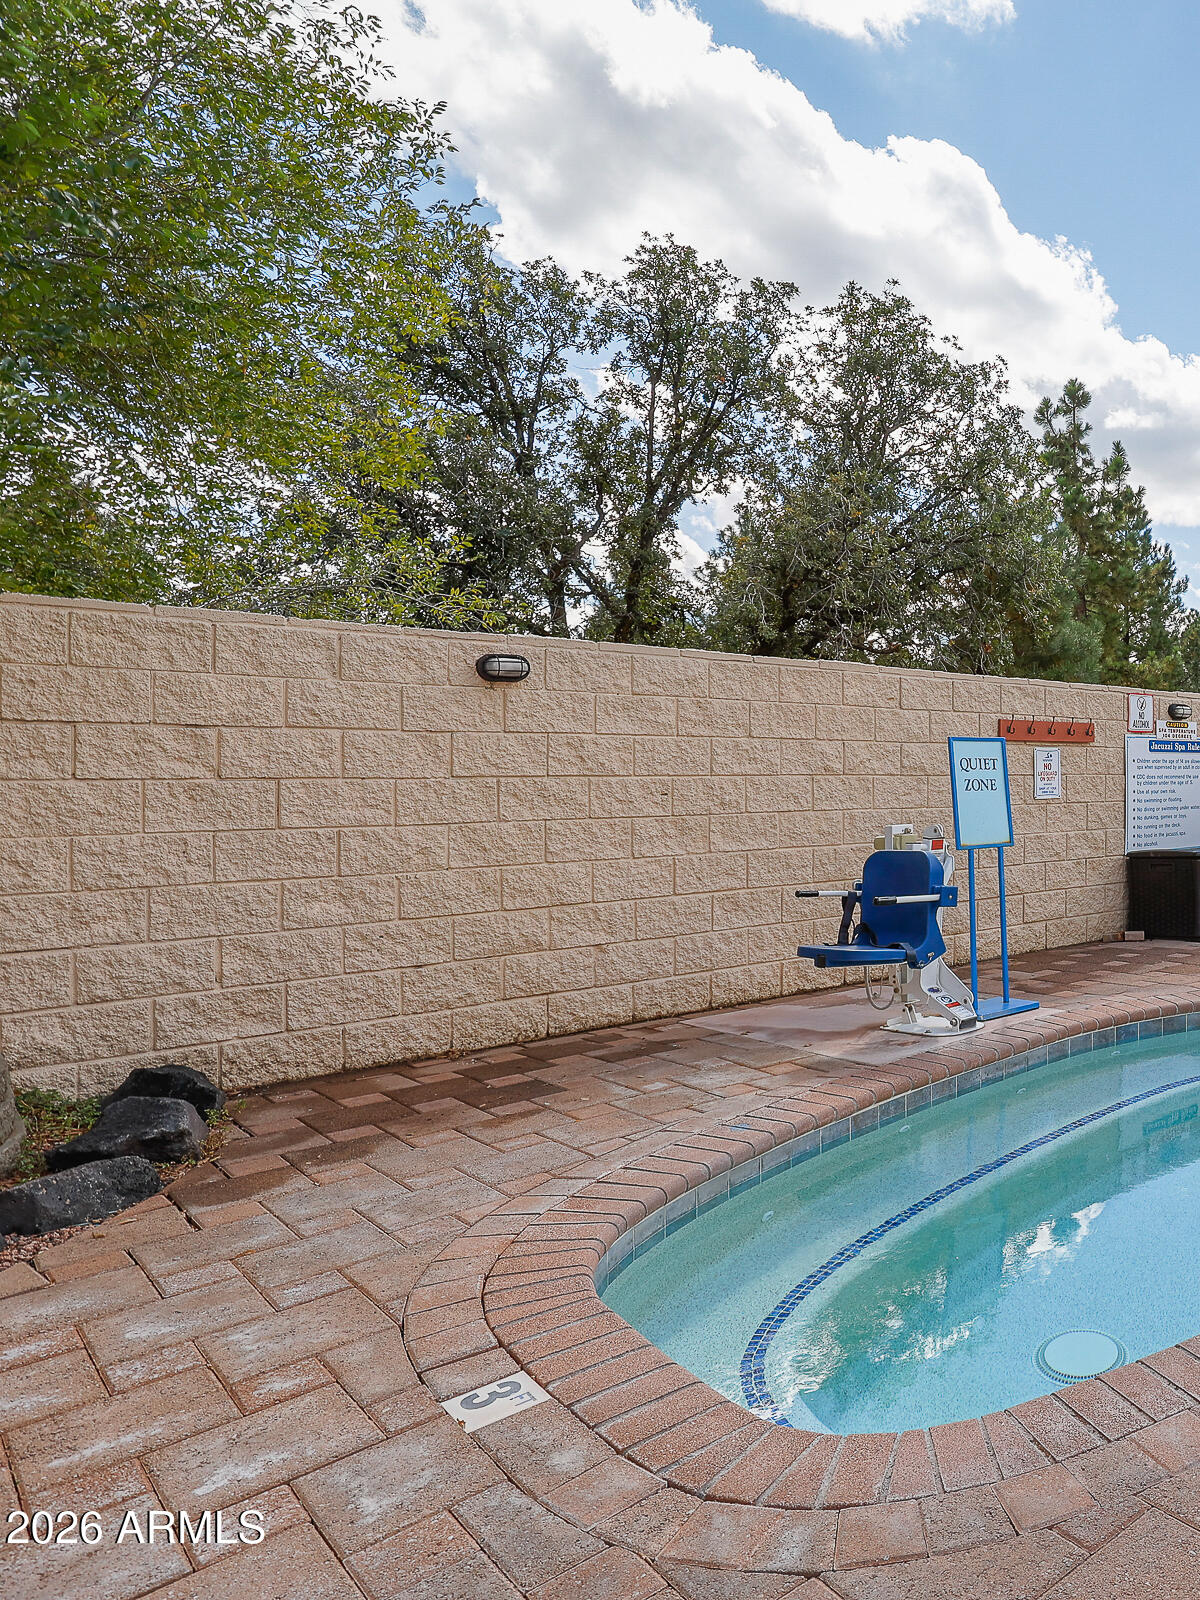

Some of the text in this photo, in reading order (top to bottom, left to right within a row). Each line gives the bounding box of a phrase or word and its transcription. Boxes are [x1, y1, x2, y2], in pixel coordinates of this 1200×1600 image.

[1133, 720, 1150, 728] ALCOHOL
[1175, 743, 1185, 751] Spa
[960, 758, 998, 772] QUIET
[964, 779, 998, 791] ZONE
[460, 1381, 521, 1410] 3
